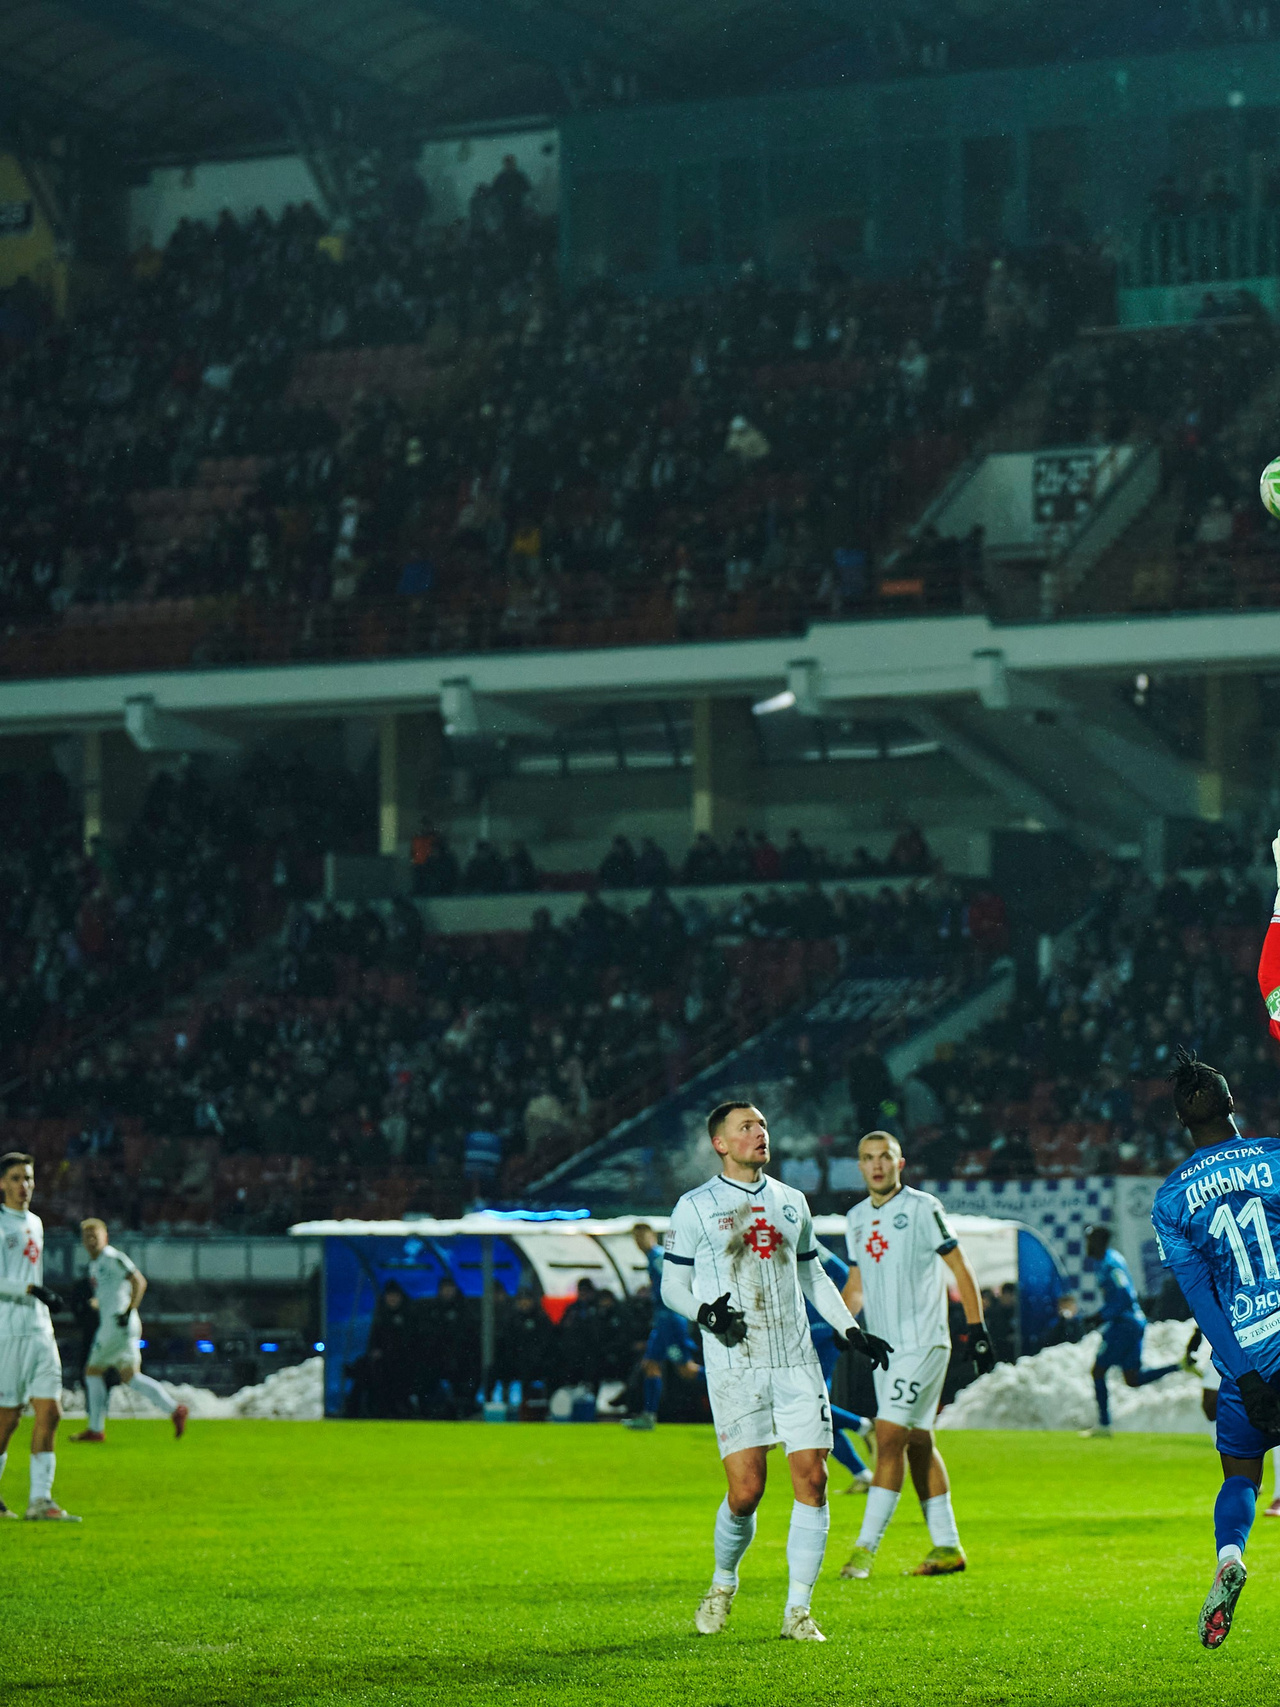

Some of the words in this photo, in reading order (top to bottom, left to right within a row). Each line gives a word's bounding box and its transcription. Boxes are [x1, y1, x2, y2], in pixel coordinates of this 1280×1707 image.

[1180, 1146, 1264, 1180] БЕЛГОССТРАХ
[1185, 1162, 1274, 1215] ДЖЫМЭ
[1208, 1197, 1280, 1286] 11
[890, 1379, 921, 1404] 55
